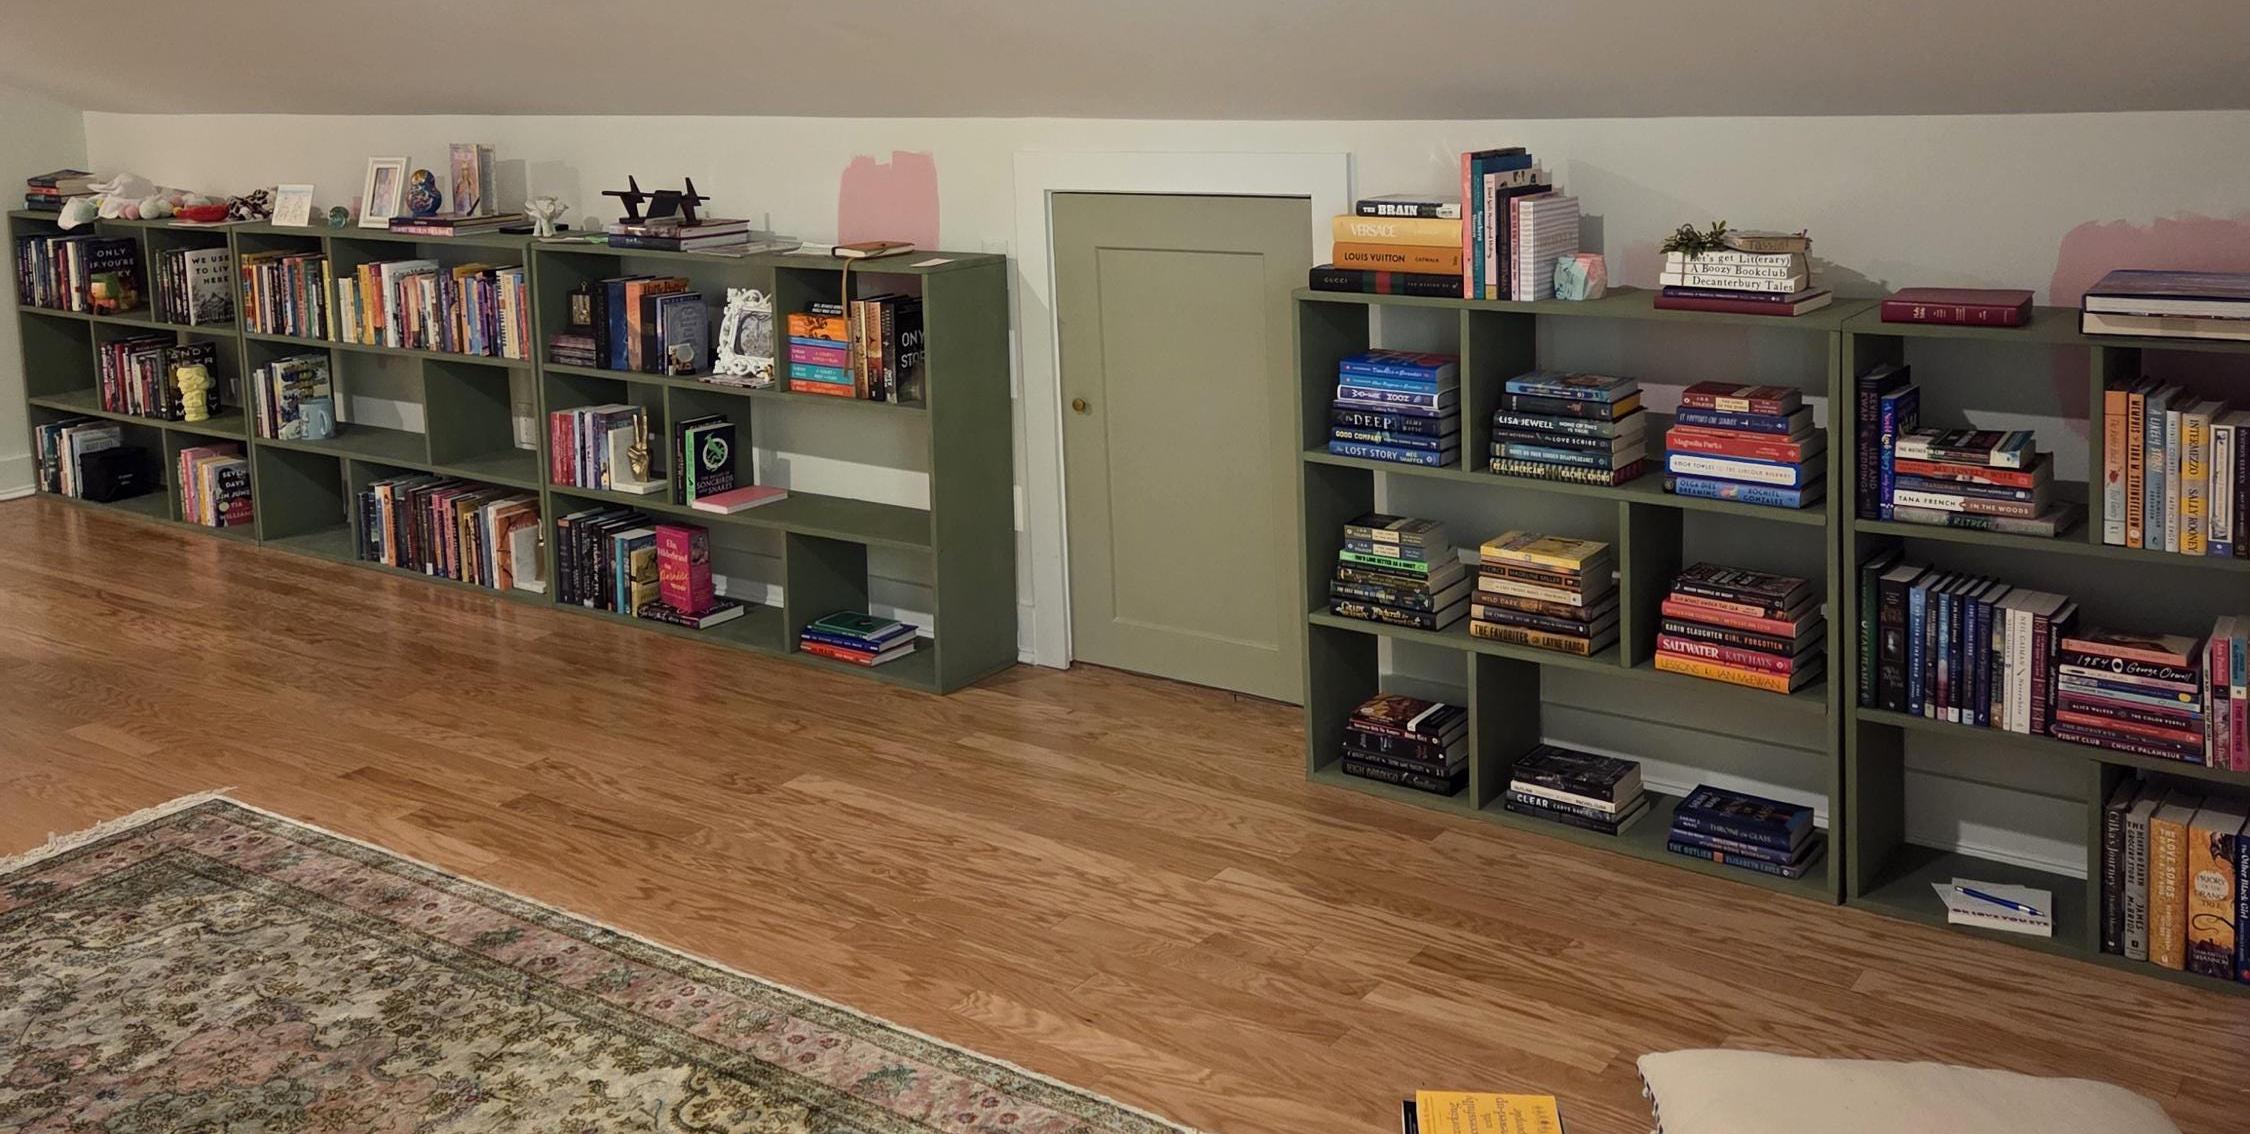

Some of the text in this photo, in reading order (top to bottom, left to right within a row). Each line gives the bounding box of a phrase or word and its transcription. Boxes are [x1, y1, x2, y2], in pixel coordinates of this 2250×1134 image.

[1378, 204, 1418, 216] BRAIN
[1350, 223, 1396, 238] VERSACE
[97, 248, 127, 258] ONLY
[192, 256, 206, 265] WE
[1344, 252, 1368, 262] LOUIS
[1370, 253, 1406, 263] VUITTON
[1690, 253, 1792, 267] Let's get Lit(erary)
[90, 258, 135, 269] IF YOU'RE
[196, 267, 208, 275] TO
[1690, 264, 1786, 278] A Boozy Bookclub
[204, 275, 229, 284] HERE
[1692, 276, 1794, 292] Decanterbury Tales
[1870, 392, 1878, 421] KEVIN
[1354, 414, 1392, 430] DEEP
[1499, 416, 1554, 429] LISA JEWELL
[2131, 400, 2141, 433] MEMPHIS
[1336, 430, 1352, 438] GOOD
[1354, 433, 1382, 442] COMPANY
[2149, 417, 2161, 445] LIKELY
[1674, 438, 1722, 449] Magnolia Parks
[1345, 446, 1398, 460] LOST STORY
[1560, 454, 1594, 463] DISAPPEARANCE
[2130, 444, 2140, 461] TARA
[2150, 447, 2162, 473] STORY
[222, 470, 246, 479] SEVEN
[1493, 462, 1545, 475] REAL AMERICANS
[1561, 469, 1610, 482] RACHEL KHONG
[1950, 465, 1985, 476] LOVELY
[1990, 471, 2013, 480] WIFE
[226, 480, 244, 488] DAYS
[1678, 487, 1717, 497] DREAMING
[1701, 482, 1716, 490] DIES
[2188, 420, 2198, 552] INTERMEZZO SALLY ROONEY
[1743, 495, 1783, 506] GONZALEZ
[1898, 496, 1920, 504] TANA
[1924, 498, 1956, 507] FRENCH
[1982, 504, 1995, 512] THE
[1998, 506, 2028, 515] WOODS
[2130, 475, 2140, 528] STRINGFELLOW
[1953, 517, 1992, 529] RETREAT
[1482, 595, 1518, 606] WILD DARK
[1474, 624, 1585, 652] THE FAVORITES LAYNE FARGO
[1666, 624, 1684, 634] KARIN
[1687, 626, 1722, 640] SLAUGHTER
[1744, 636, 1782, 650] FORGOTTEN
[1663, 639, 1772, 668] SALTWATER KATY HAYS
[1660, 659, 1781, 690] LESSONS IAN McEWAN
[2077, 656, 2191, 681] 1984 George Orwell
[2217, 656, 2225, 681] Patchett
[2091, 706, 2113, 715] WALKER
[2143, 715, 2162, 723] COLOR
[2165, 718, 2186, 726] PURPLE
[2058, 733, 2180, 759] FIGHT CLUB CHUCK PALAHNIUK
[1516, 794, 1594, 817] CLEAR CARYS DAVIES
[1710, 824, 1771, 842] THRONE GLASS
[1669, 843, 1712, 859] THE OUTLIER
[2106, 811, 2120, 886] Cilka's Journey
[2128, 829, 2136, 860] GROCERY
[2136, 830, 2144, 856] HEARTH
[2166, 838, 2175, 864] LOVE
[2241, 855, 2249, 877] Other
[2166, 866, 2175, 898] SONGS
[2197, 874, 2225, 886] PRIORY
[2241, 879, 2250, 901] Black
[2201, 900, 2220, 908] TREE
[2240, 903, 2250, 919] Girl
[2127, 896, 2135, 934] McBRIDE
[2136, 904, 2144, 930] JAMES
[2193, 954, 2228, 965] SHANNON
